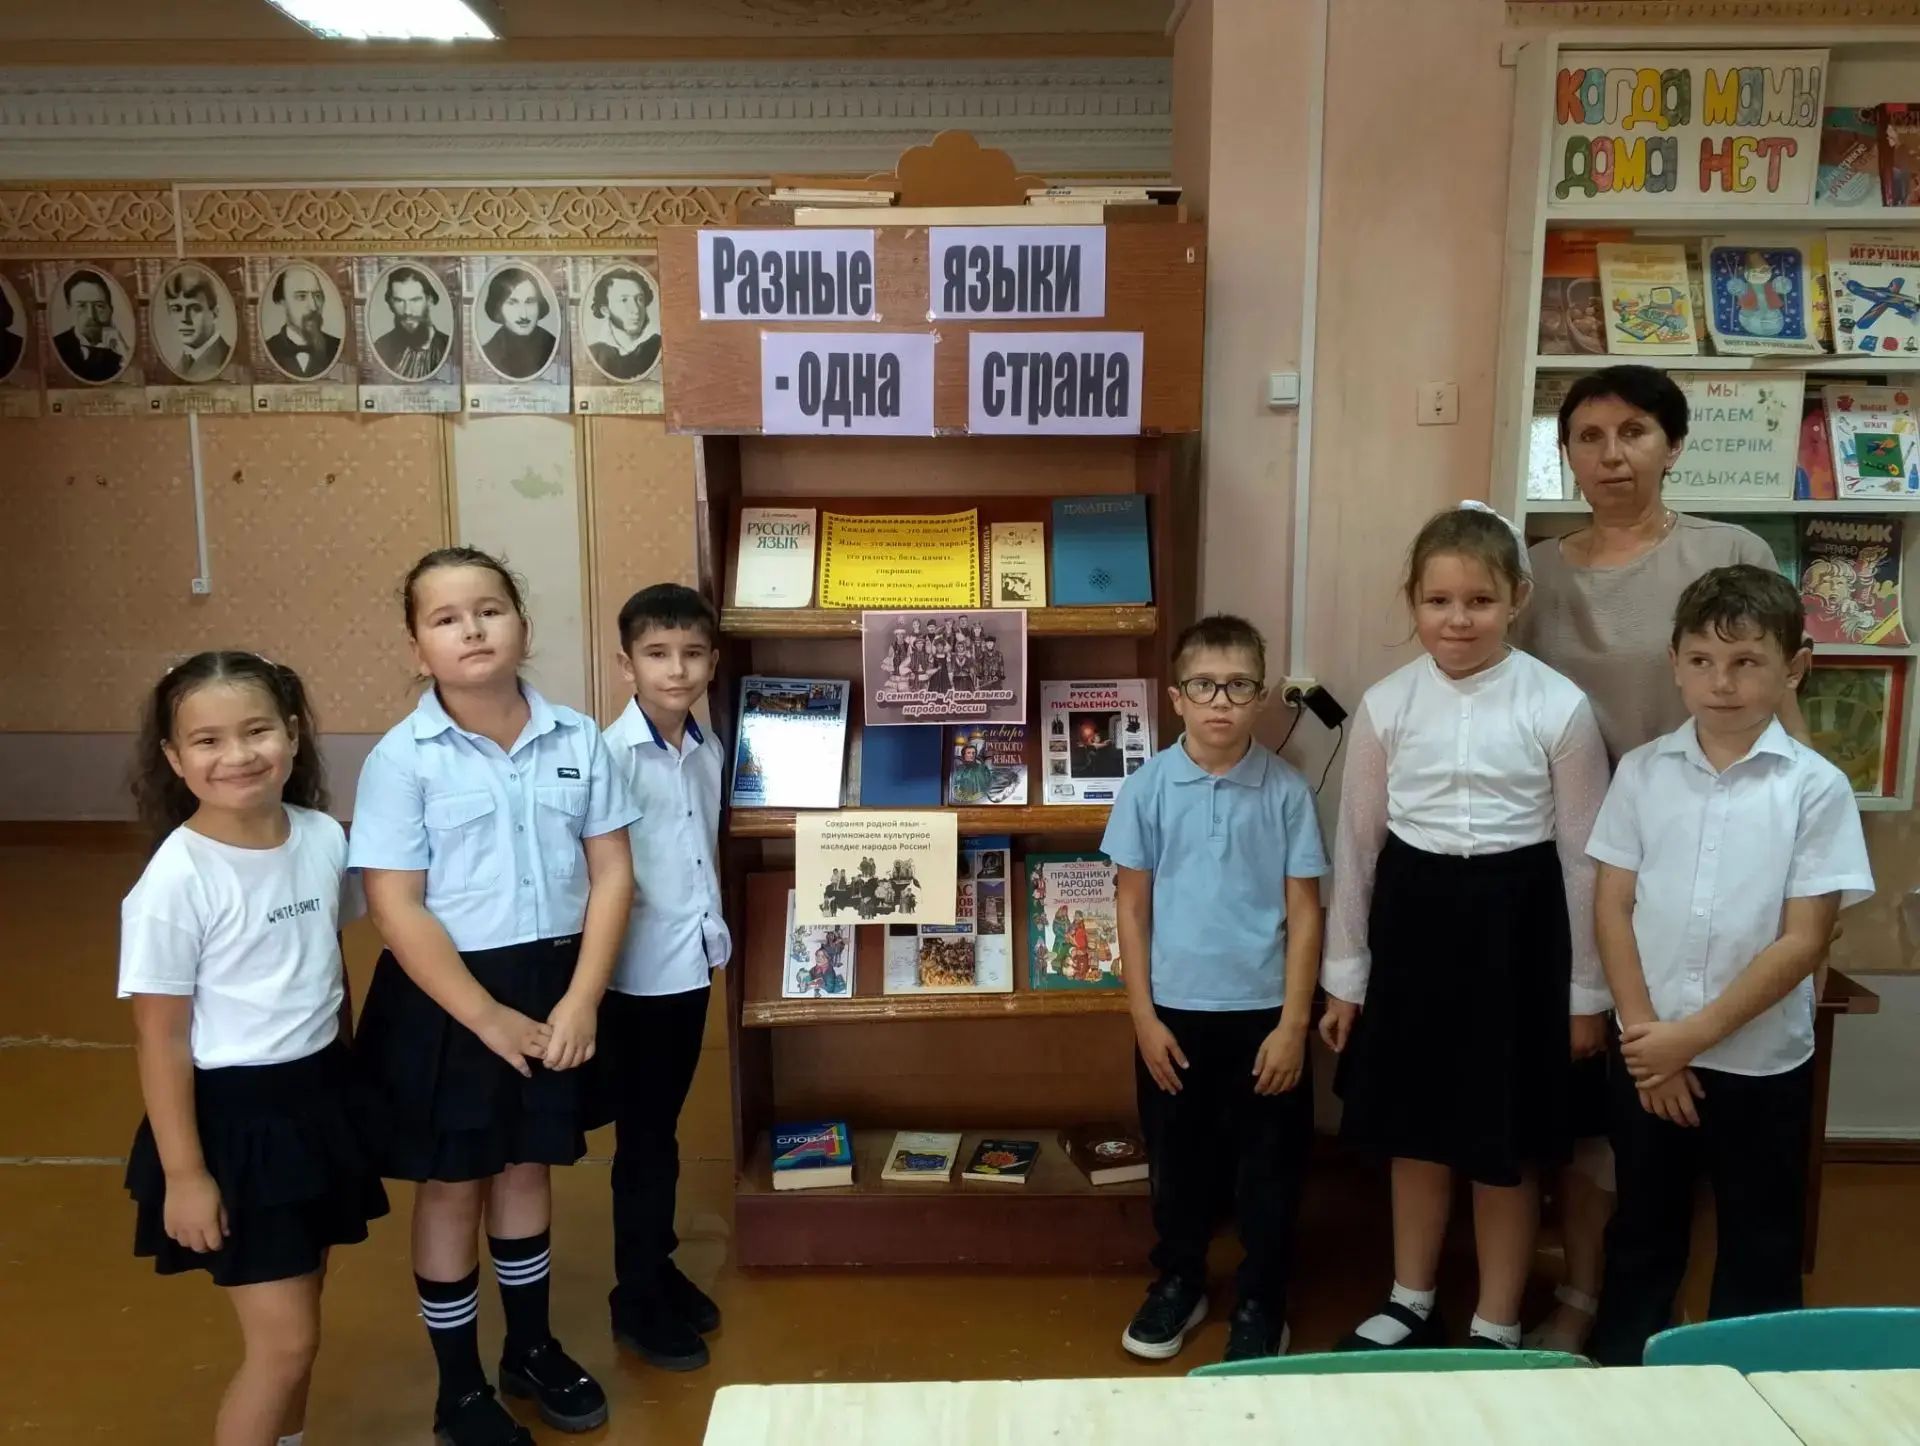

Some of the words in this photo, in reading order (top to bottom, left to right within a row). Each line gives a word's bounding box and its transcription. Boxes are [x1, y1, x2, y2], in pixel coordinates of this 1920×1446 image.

[1700, 136, 1797, 193] НЕТ
[713, 236, 872, 316] Разные
[943, 244, 1082, 313] языки
[798, 351, 901, 427] одна
[982, 351, 1130, 425] страна
[1707, 382, 1738, 397] МЫ
[747, 521, 811, 536] РУССКИЙ
[757, 536, 799, 549] ЯЗЫК
[877, 691, 884, 701] 8
[886, 690, 938, 702] сентября
[944, 690, 972, 702] День
[974, 690, 1012, 700] языков
[1070, 691, 1118, 699] РУССКАЯ
[903, 703, 947, 716] народов
[949, 703, 987, 714] России
[1051, 700, 1139, 709] ПИСЬМЕННОСТЬ
[866, 820, 898, 829] родной
[821, 832, 881, 840] приумножаем
[883, 832, 931, 841] культурное
[820, 843, 860, 851] наследие
[861, 843, 898, 851] народов
[899, 842, 931, 851] России!
[1050, 870, 1111, 880] ПРАЗДНИКИ
[1057, 879, 1104, 888] НАРОДОВ
[1060, 888, 1102, 897] РОССИИ
